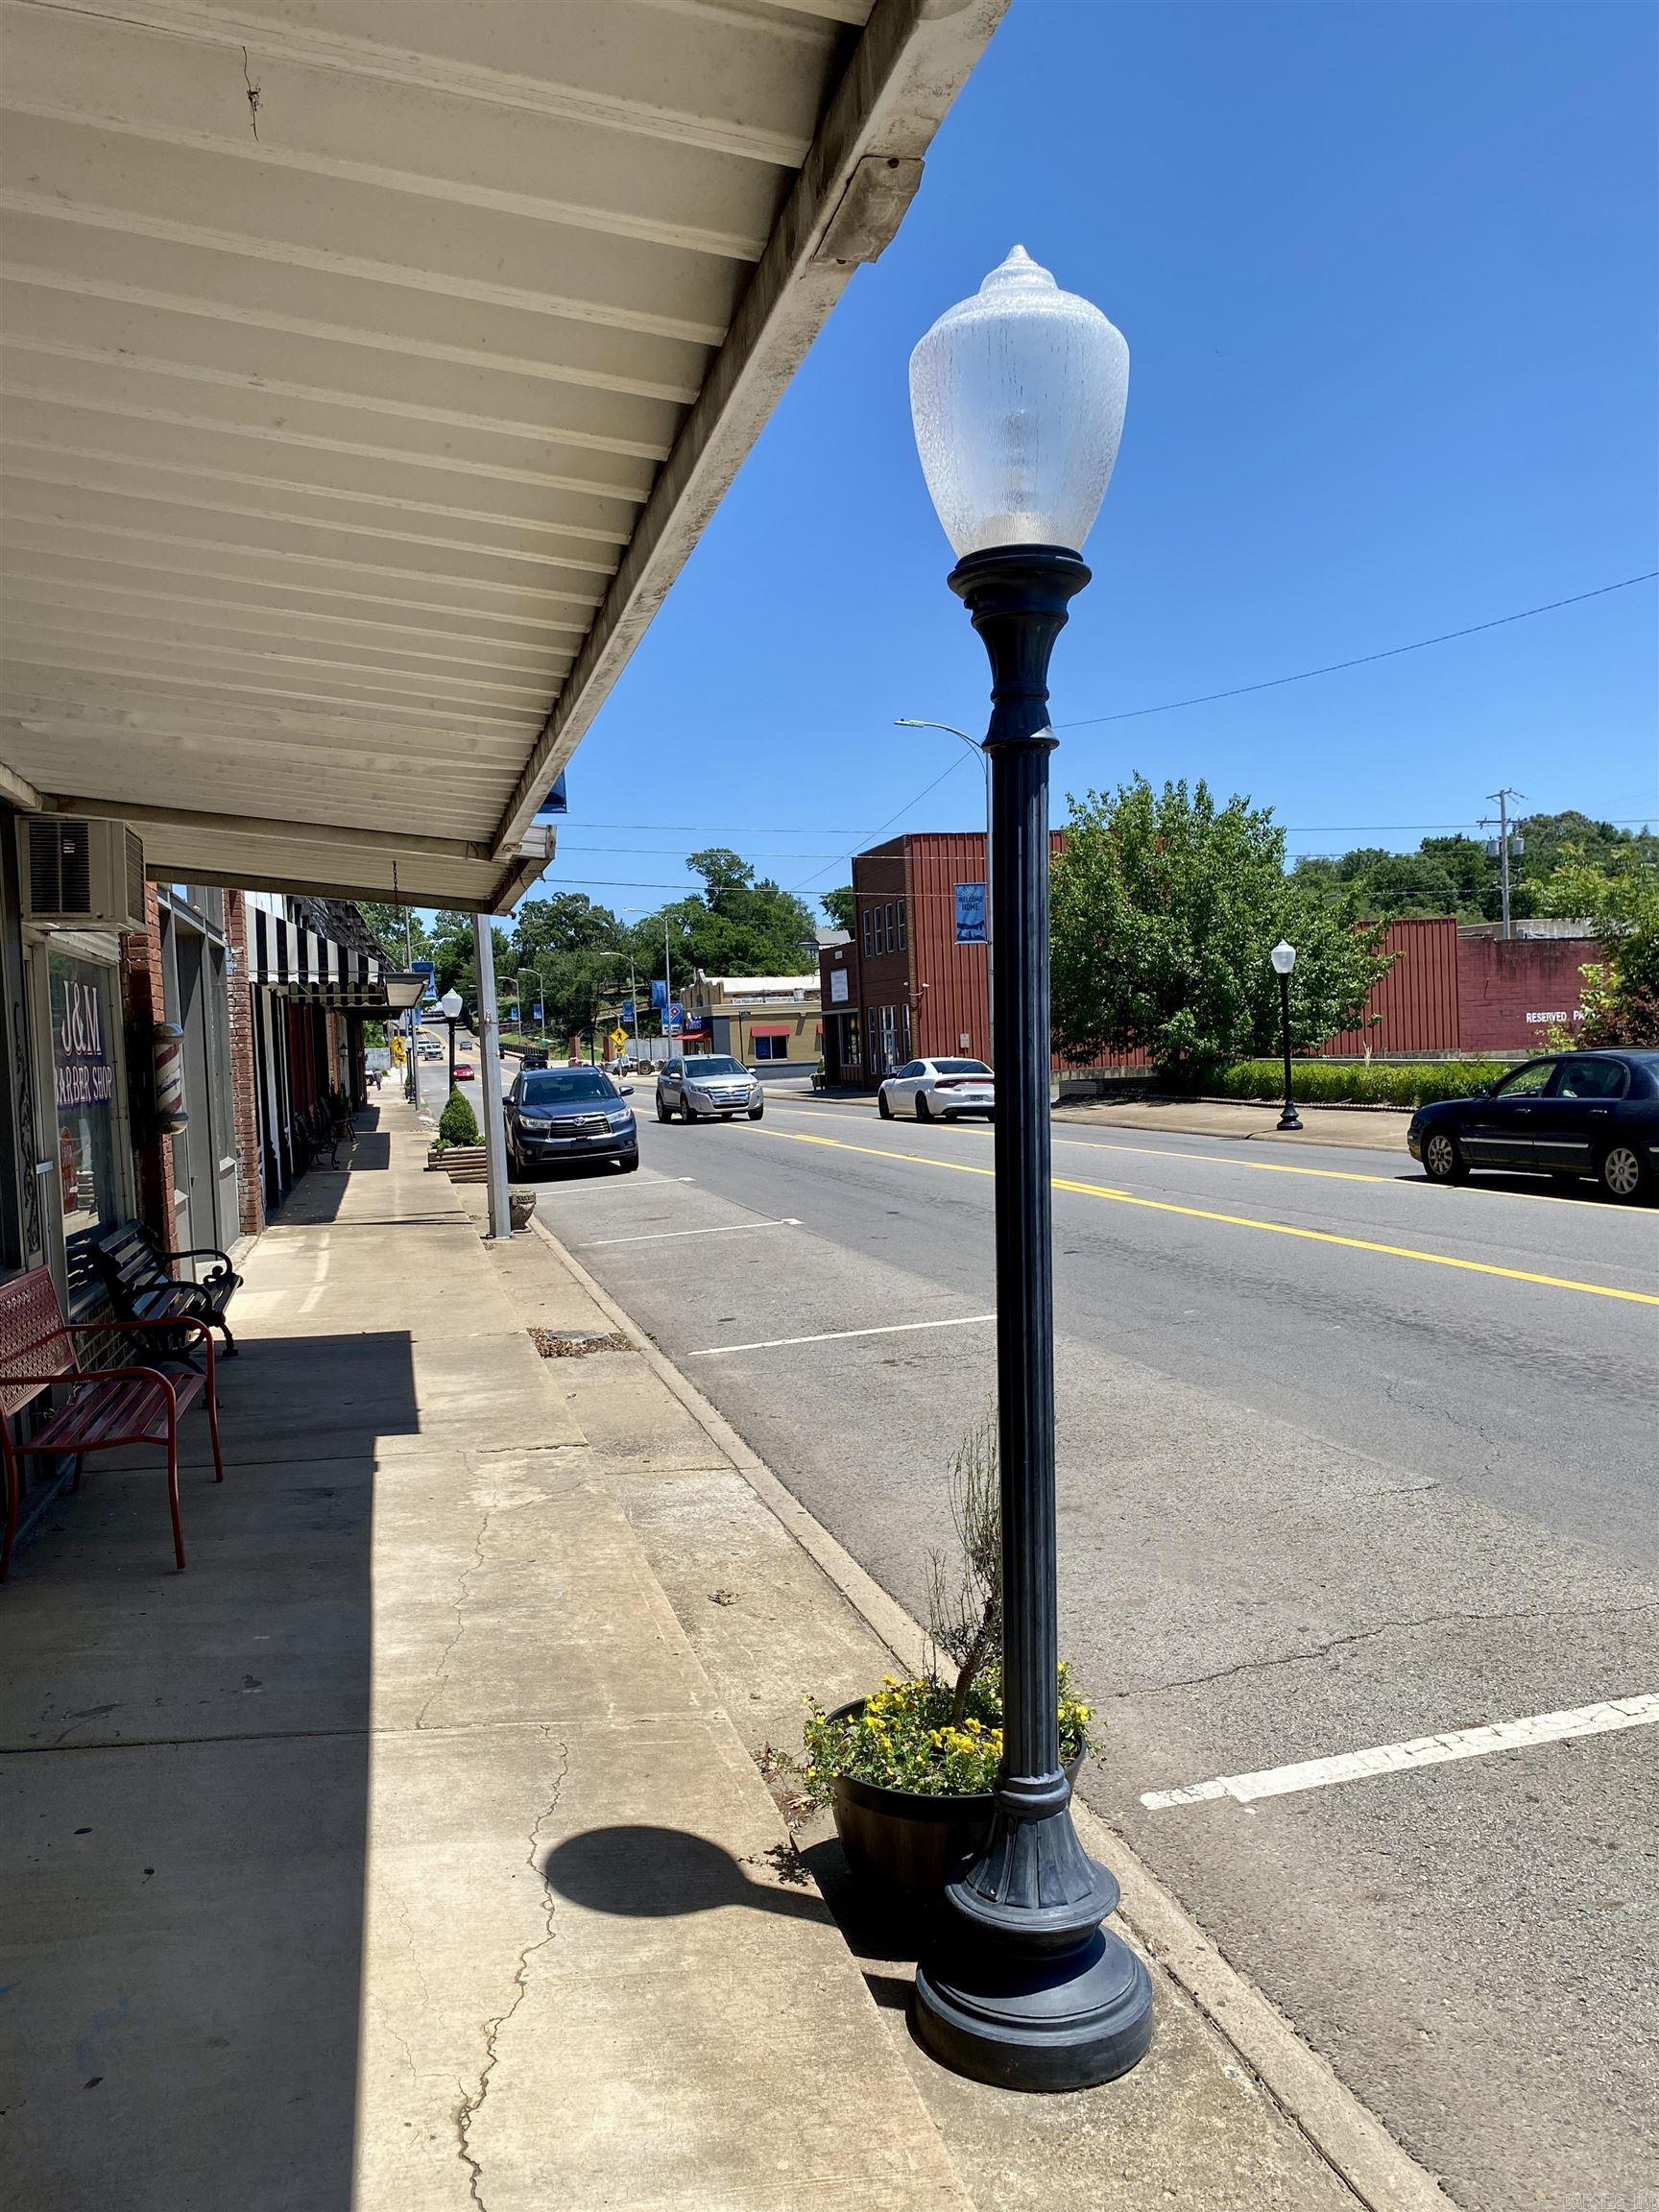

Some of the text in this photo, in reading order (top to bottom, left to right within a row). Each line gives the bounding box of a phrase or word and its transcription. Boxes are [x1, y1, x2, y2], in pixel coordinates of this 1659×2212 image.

[961, 902, 979, 911] HOME
[61, 980, 102, 1056] J&M
[1526, 1011, 1567, 1023] RESERVED
[92, 1066, 112, 1100] SHOP
